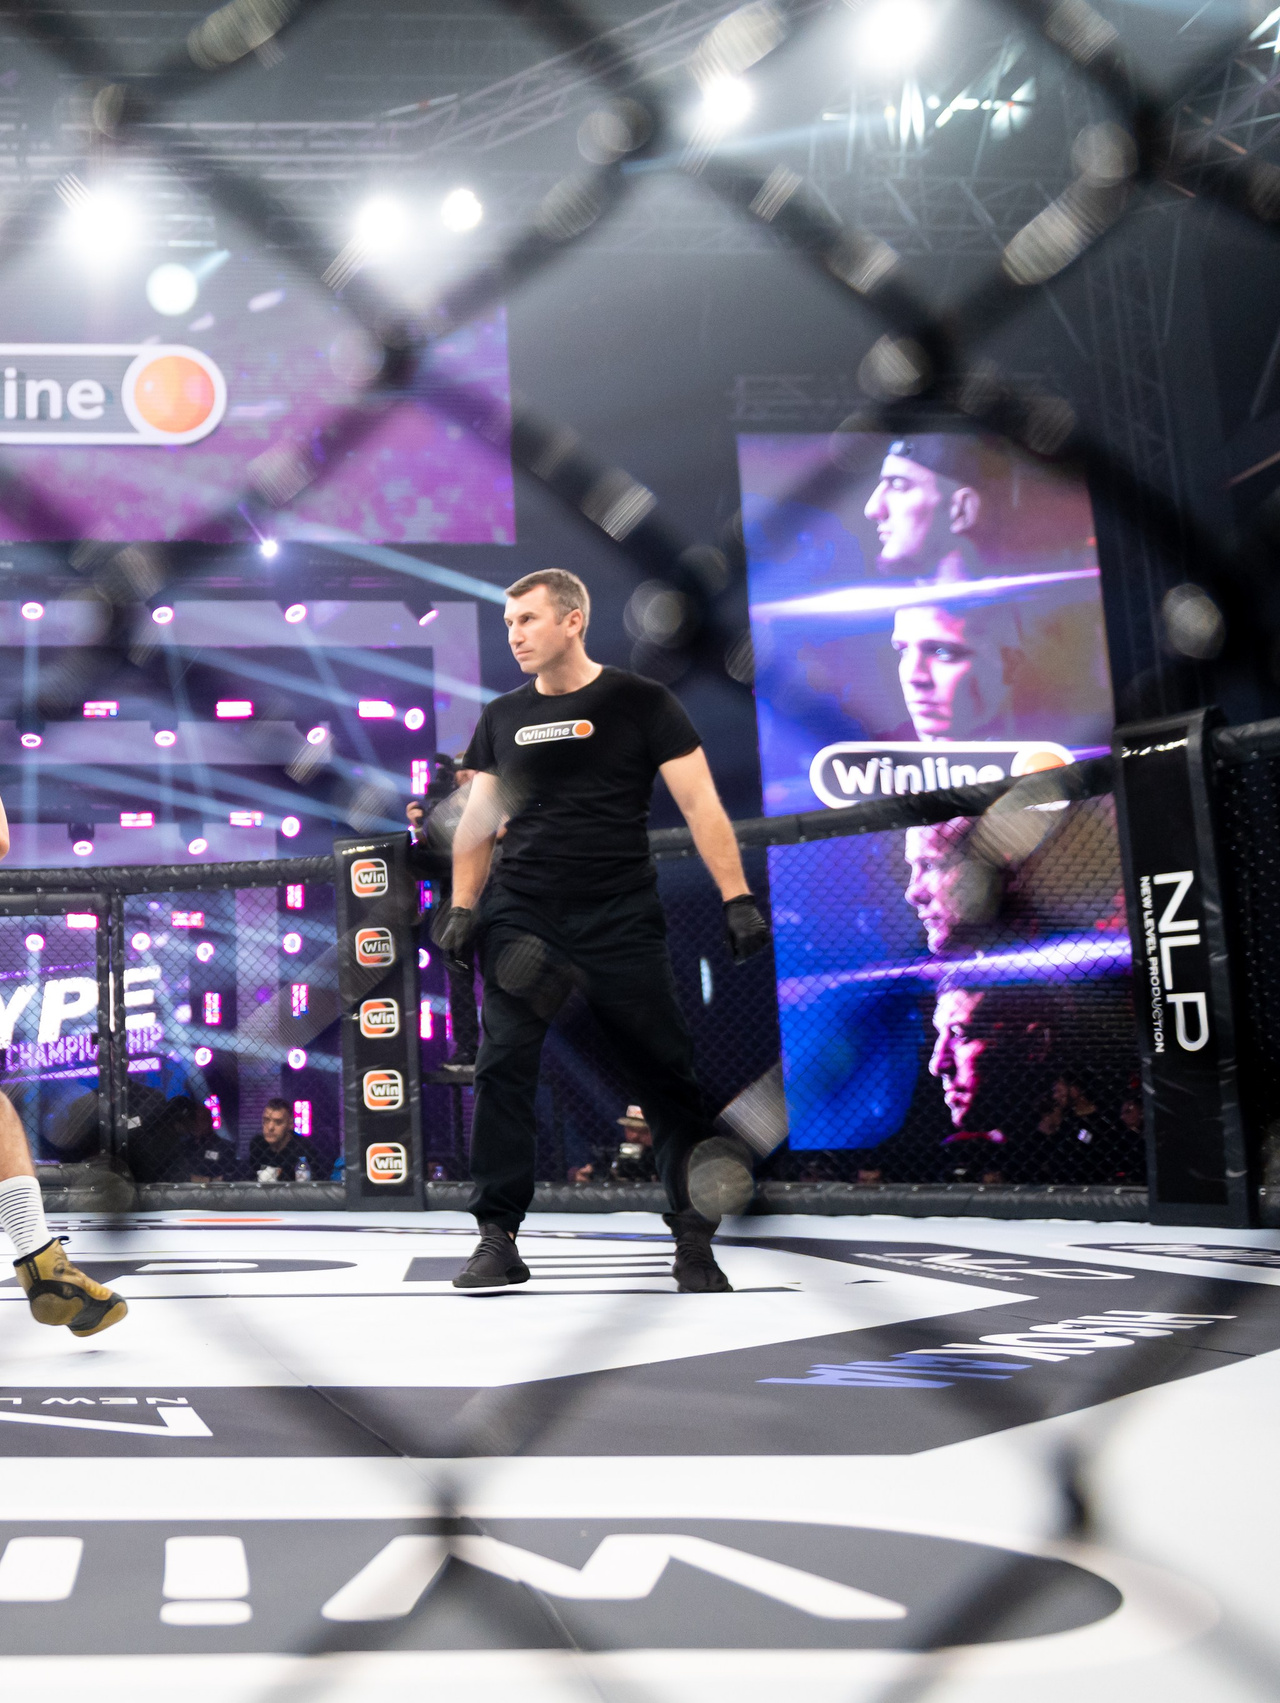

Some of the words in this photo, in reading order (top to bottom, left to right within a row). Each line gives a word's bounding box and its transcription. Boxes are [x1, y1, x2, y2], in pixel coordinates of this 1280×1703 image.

[522, 727, 570, 741] Winline
[831, 756, 1006, 795] Winline
[360, 871, 385, 884] Win
[1140, 875, 1153, 909] NEW
[1143, 910, 1158, 955] LEVEL
[363, 941, 390, 953] Win
[1153, 870, 1210, 1052] NLP
[1147, 956, 1165, 1053] PRODUCTION
[369, 1010, 395, 1024] Win
[371, 1083, 399, 1097] Win
[374, 1157, 402, 1170] Win
[41, 1396, 189, 1405] NEW
